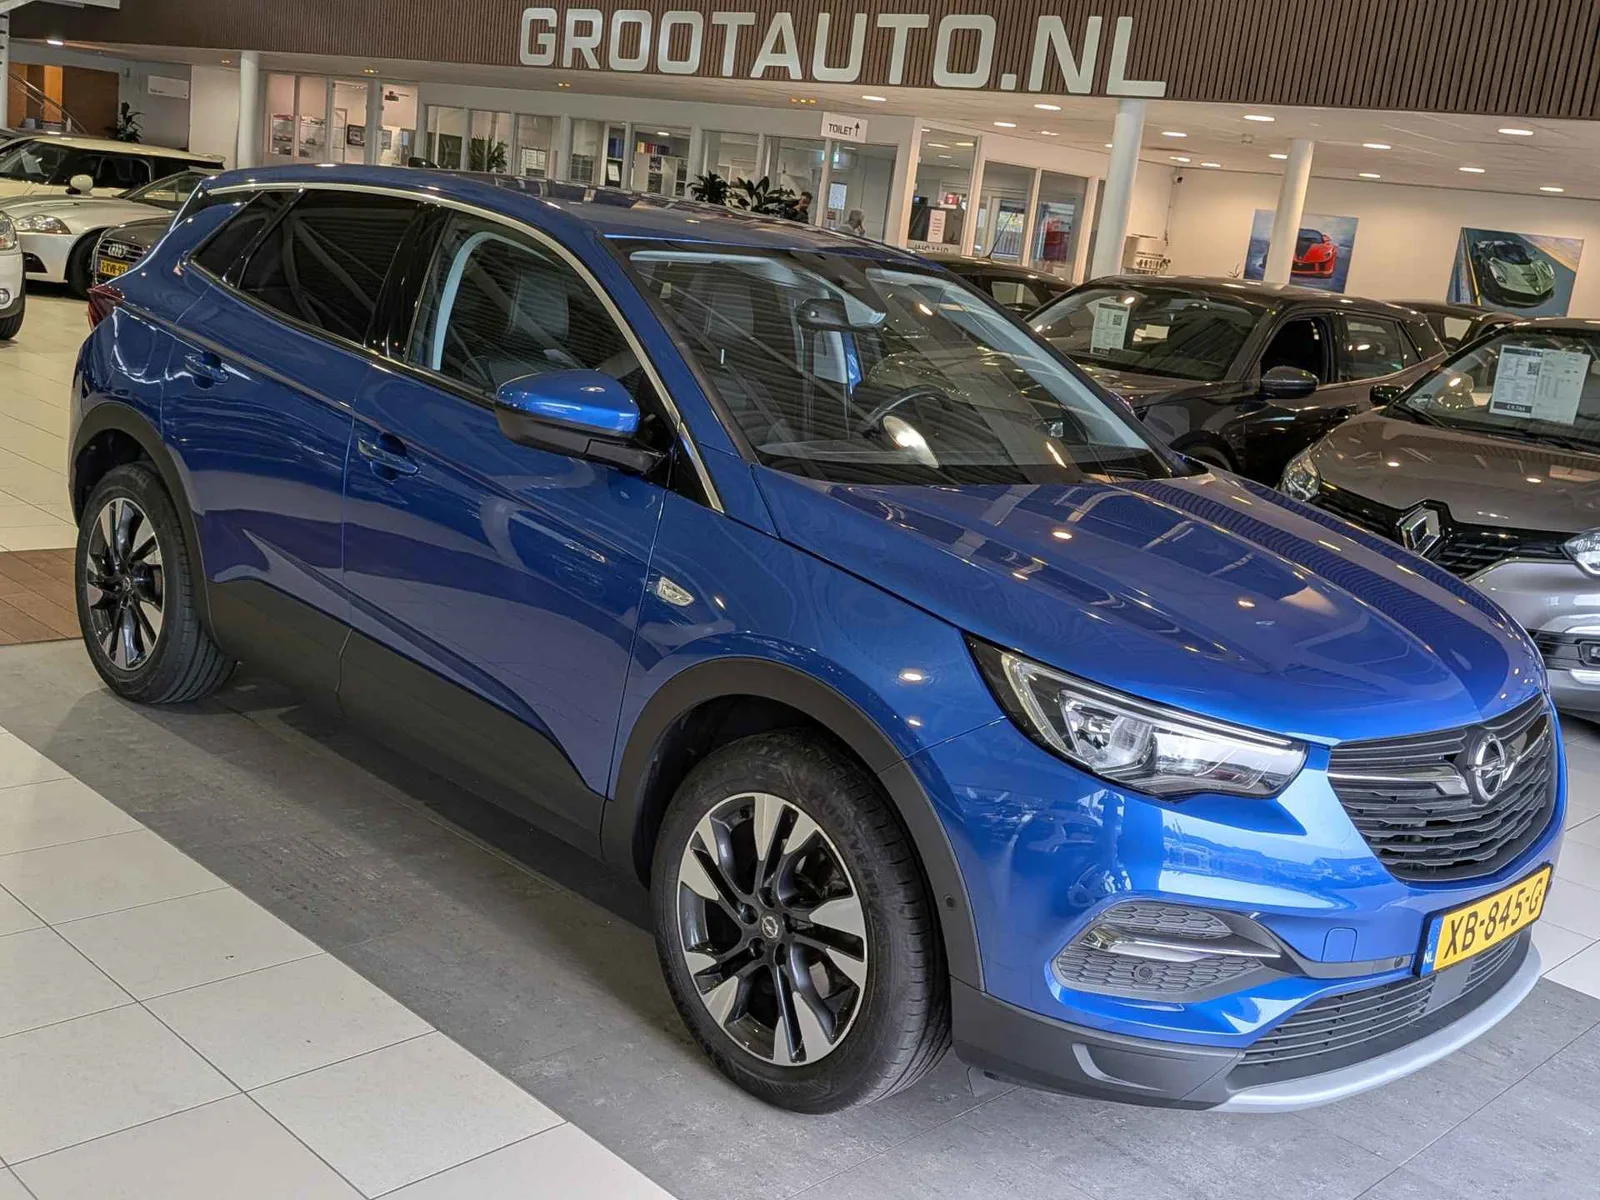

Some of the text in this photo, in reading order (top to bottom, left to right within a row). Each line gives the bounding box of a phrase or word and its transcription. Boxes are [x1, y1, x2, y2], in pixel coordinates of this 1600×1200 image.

[519, 7, 1167, 97] GROOTAUTO.NL
[828, 122, 853, 136] TOILET
[1443, 877, 1544, 960] XB-845-G
[1423, 952, 1434, 964] NL
